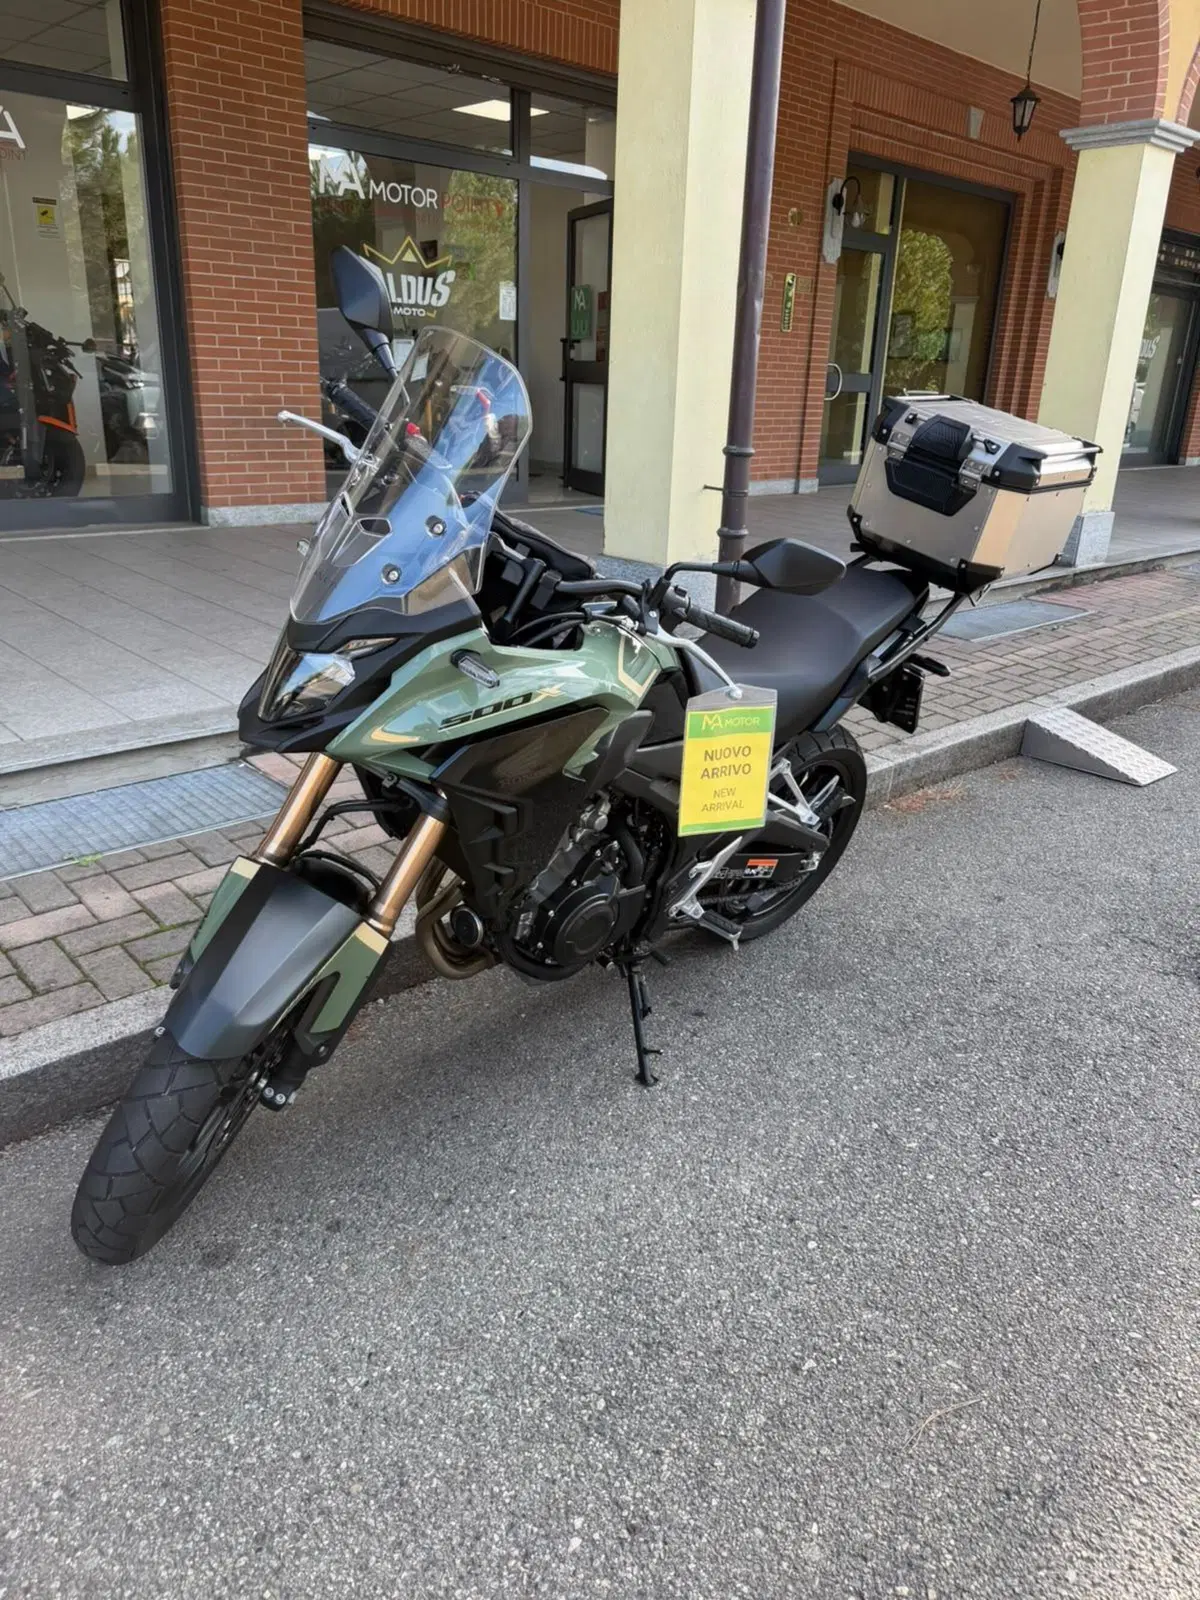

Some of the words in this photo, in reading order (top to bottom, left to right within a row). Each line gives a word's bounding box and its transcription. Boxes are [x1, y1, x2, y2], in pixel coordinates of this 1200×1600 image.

[368, 179, 438, 209] MOTOR
[386, 269, 456, 307] LDUS
[393, 307, 426, 317] MOTO
[702, 713, 723, 731] MA
[724, 716, 761, 728] MOTOR
[704, 745, 752, 762] NUOVO
[700, 763, 752, 780] ARRIVO
[713, 787, 736, 798] NEW
[702, 800, 744, 812] ARRIVAL
